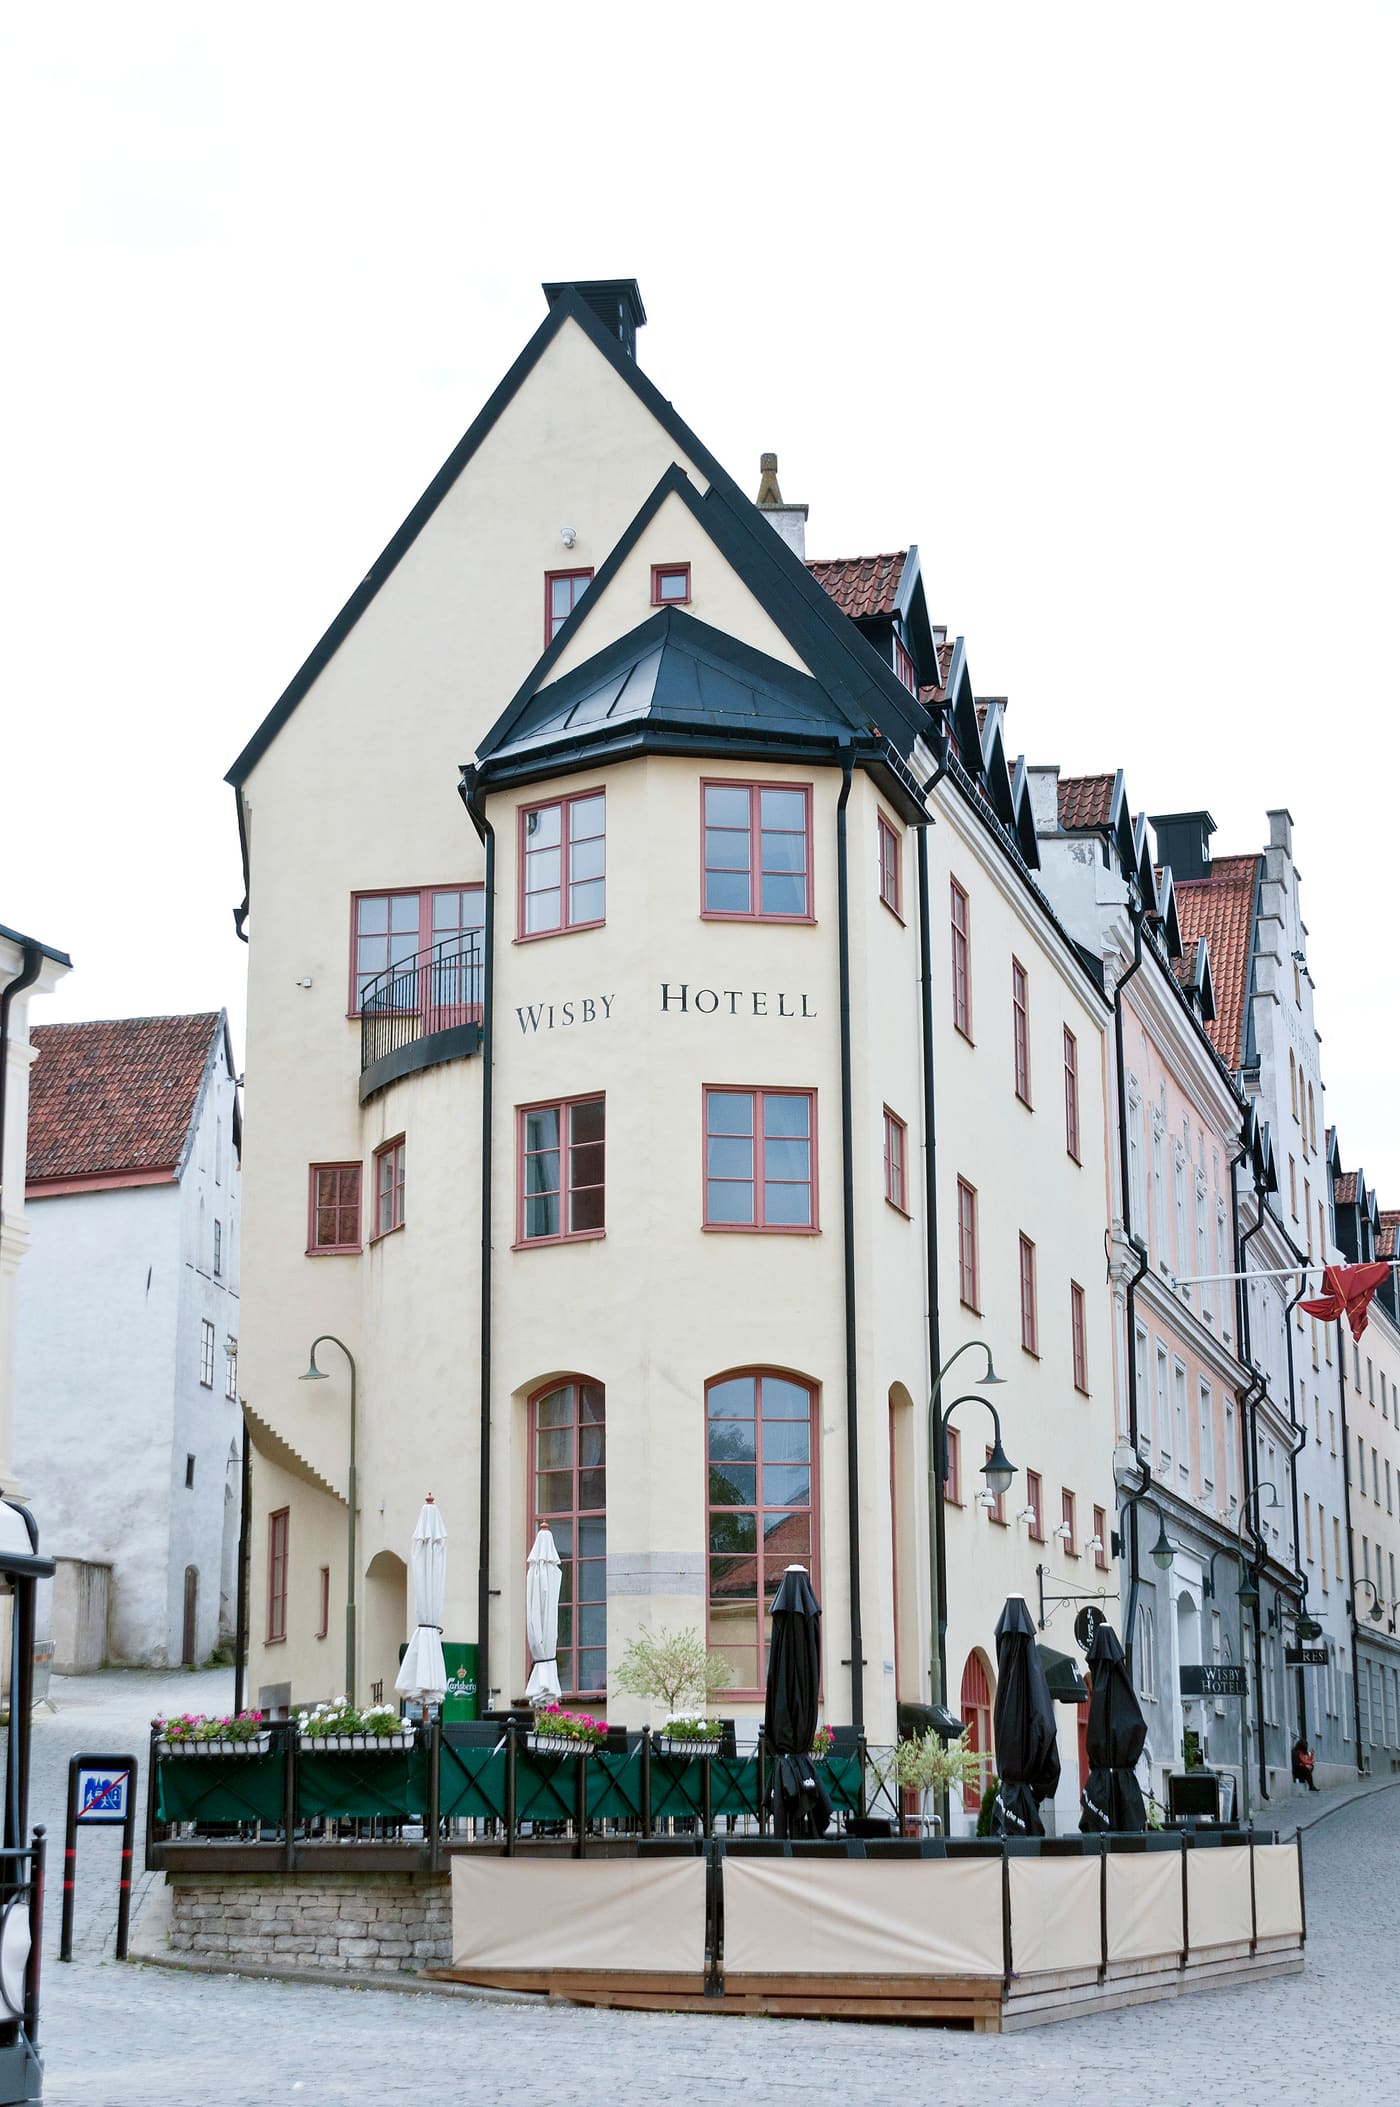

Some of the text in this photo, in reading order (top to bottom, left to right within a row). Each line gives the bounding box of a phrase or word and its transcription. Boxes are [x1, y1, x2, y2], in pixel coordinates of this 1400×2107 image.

[514, 983, 818, 1035] WISBY HOTELL
[1203, 1667, 1240, 1681] WISBY
[447, 1677, 477, 1694] Carlsberg
